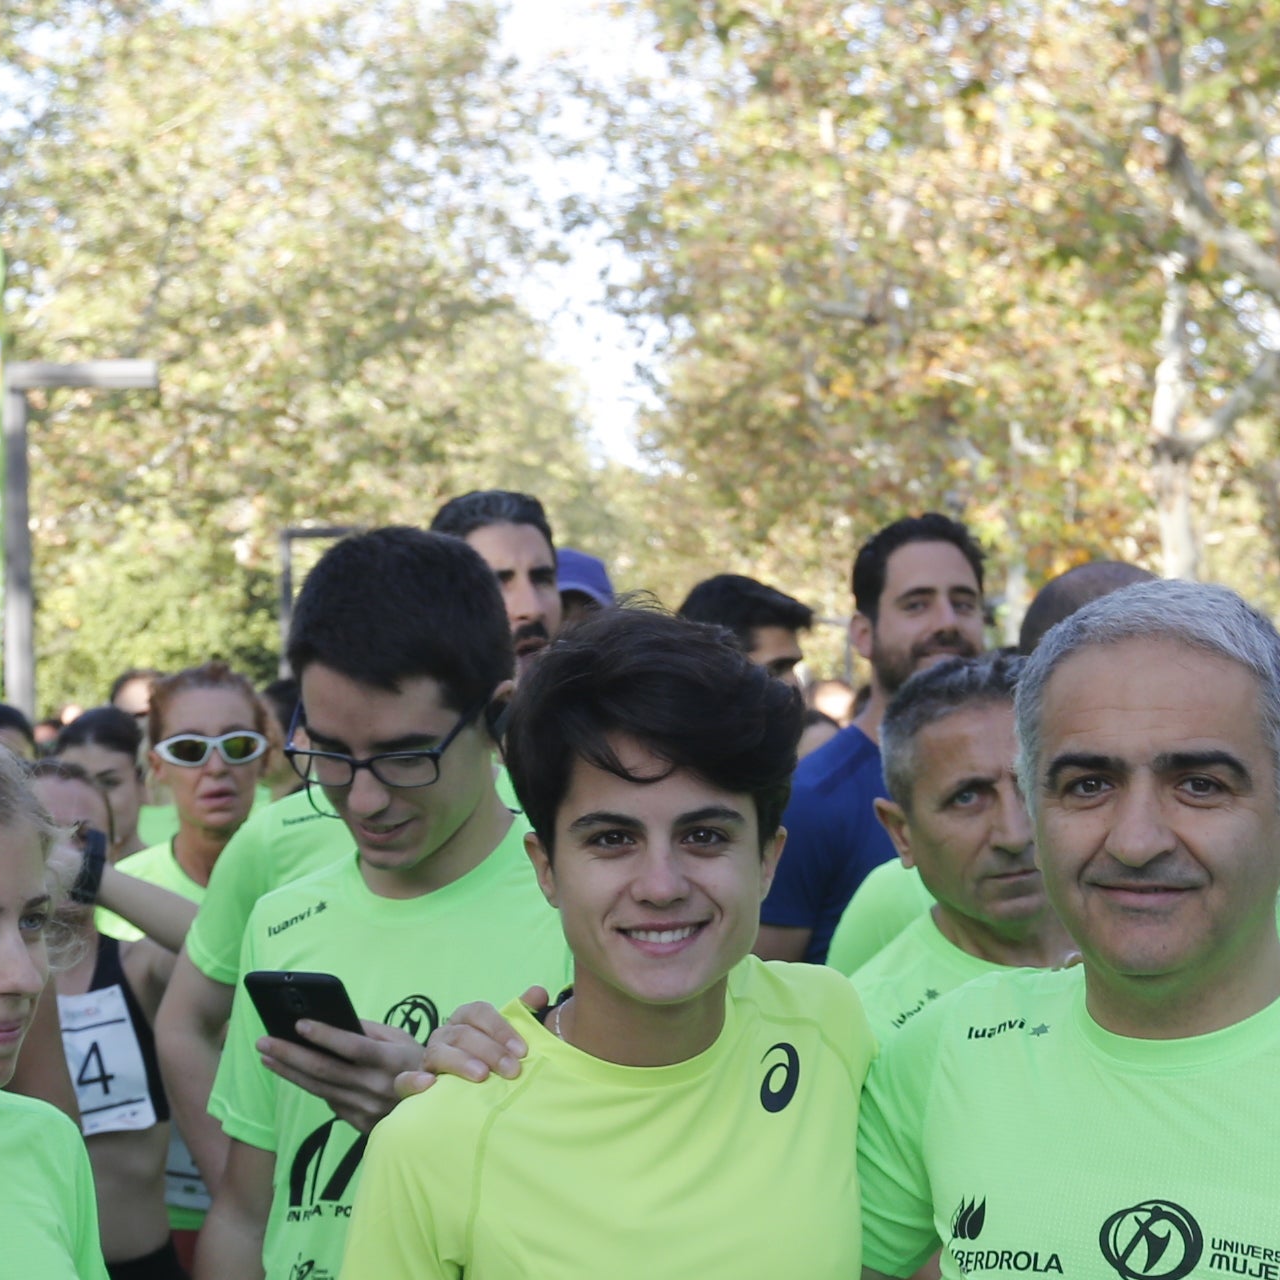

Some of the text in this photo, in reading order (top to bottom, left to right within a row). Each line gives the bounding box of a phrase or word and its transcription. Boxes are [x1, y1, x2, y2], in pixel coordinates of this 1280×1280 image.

[268, 907, 311, 936] luanvi
[967, 1018, 1025, 1039] luanvi
[77, 1041, 114, 1095] 4
[951, 1249, 1063, 1275] IBERDROLA
